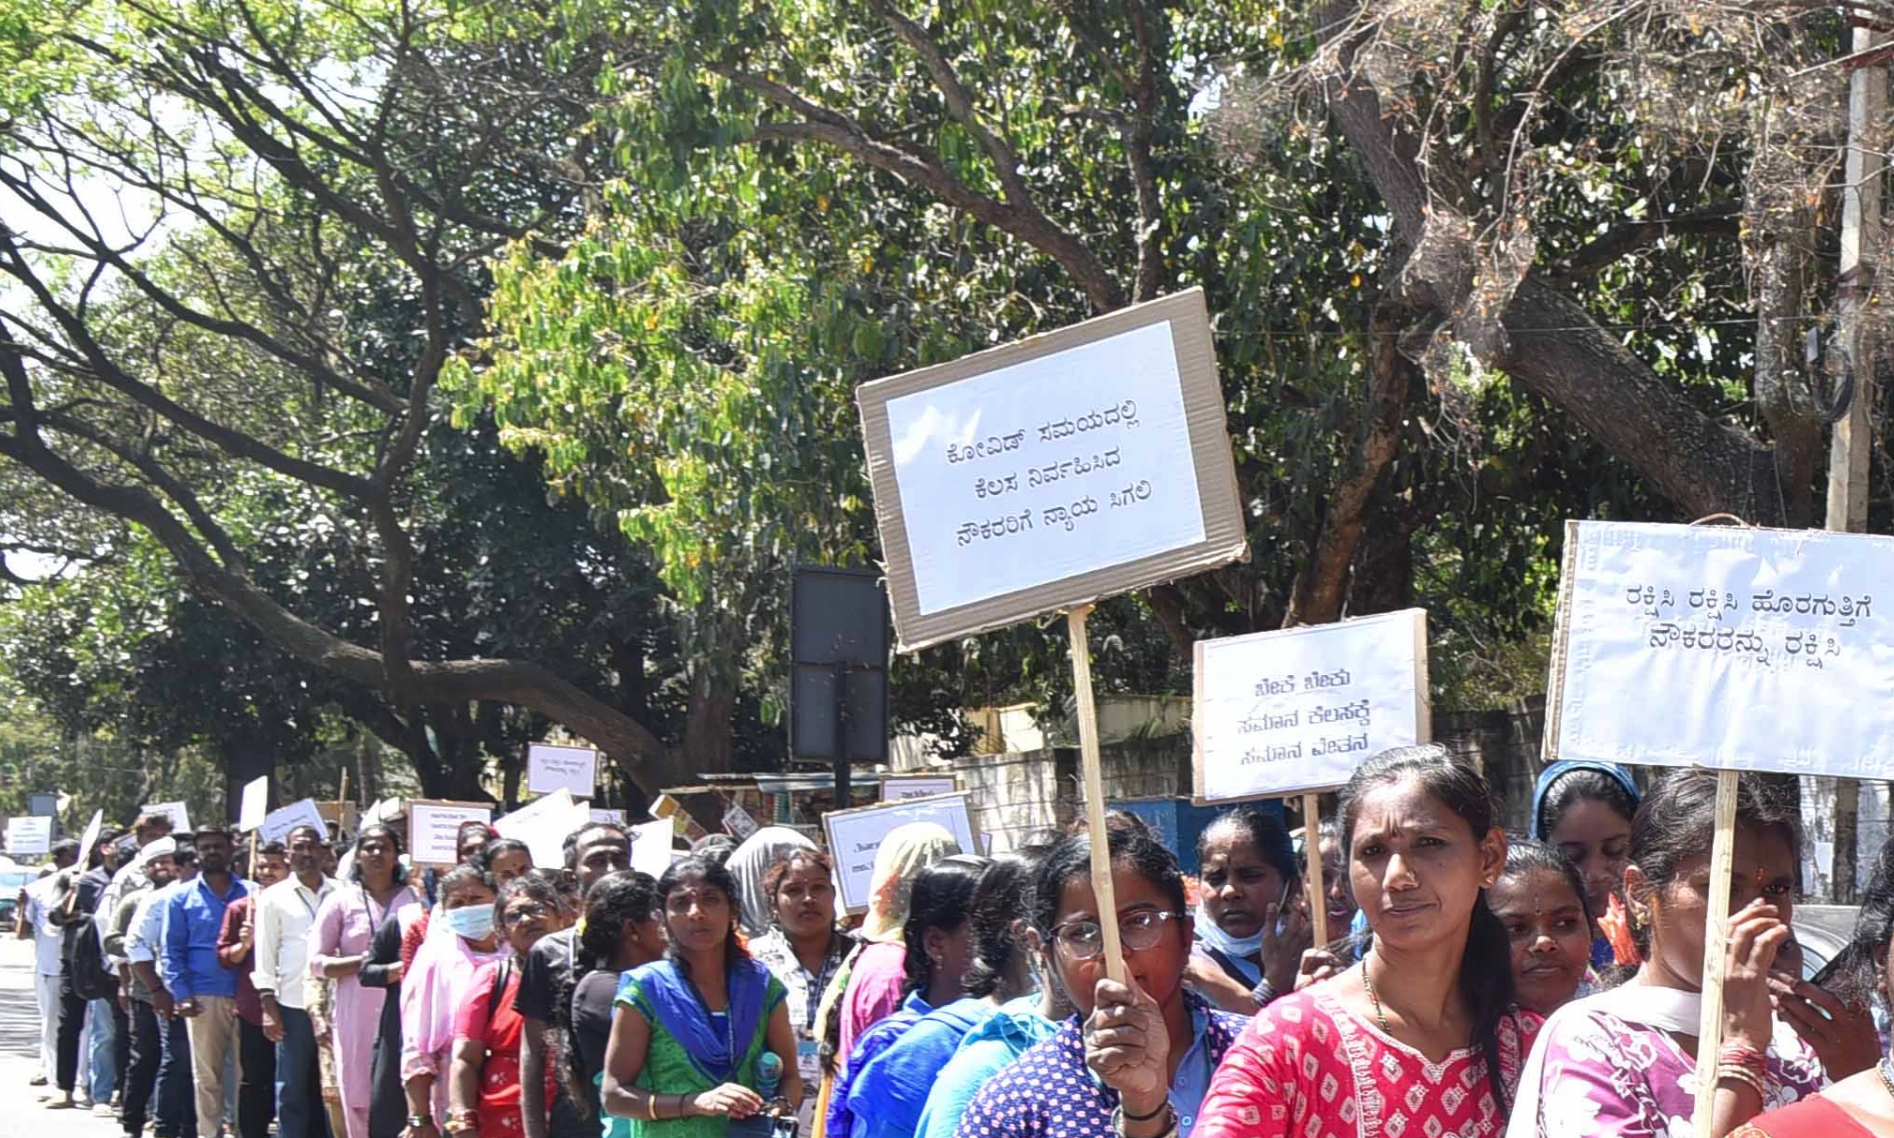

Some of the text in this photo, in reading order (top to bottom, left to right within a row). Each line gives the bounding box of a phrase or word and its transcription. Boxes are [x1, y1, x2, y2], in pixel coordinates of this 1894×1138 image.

[947, 399, 1140, 464] ಕೋವಿಡ್ ಸಮಯದಲ್ಲಿ
[975, 446, 1121, 499] ಕೆಲಸ ನಿರ್ವಹಿಸಿದ
[957, 478, 1152, 546] ನೌಕರರಿಗೆ ನ್ಯಾಯ ಸಿಗಲಿ
[1626, 584, 1872, 627] ರಕ್ಷಿಸಿ ರಕ್ಷಿಸಿ ಹೊರಗುತ್ತಿಗೆ
[1649, 622, 1841, 668] ನೌಕರರನ್ನು ರಕ್ಷಿಸಿ
